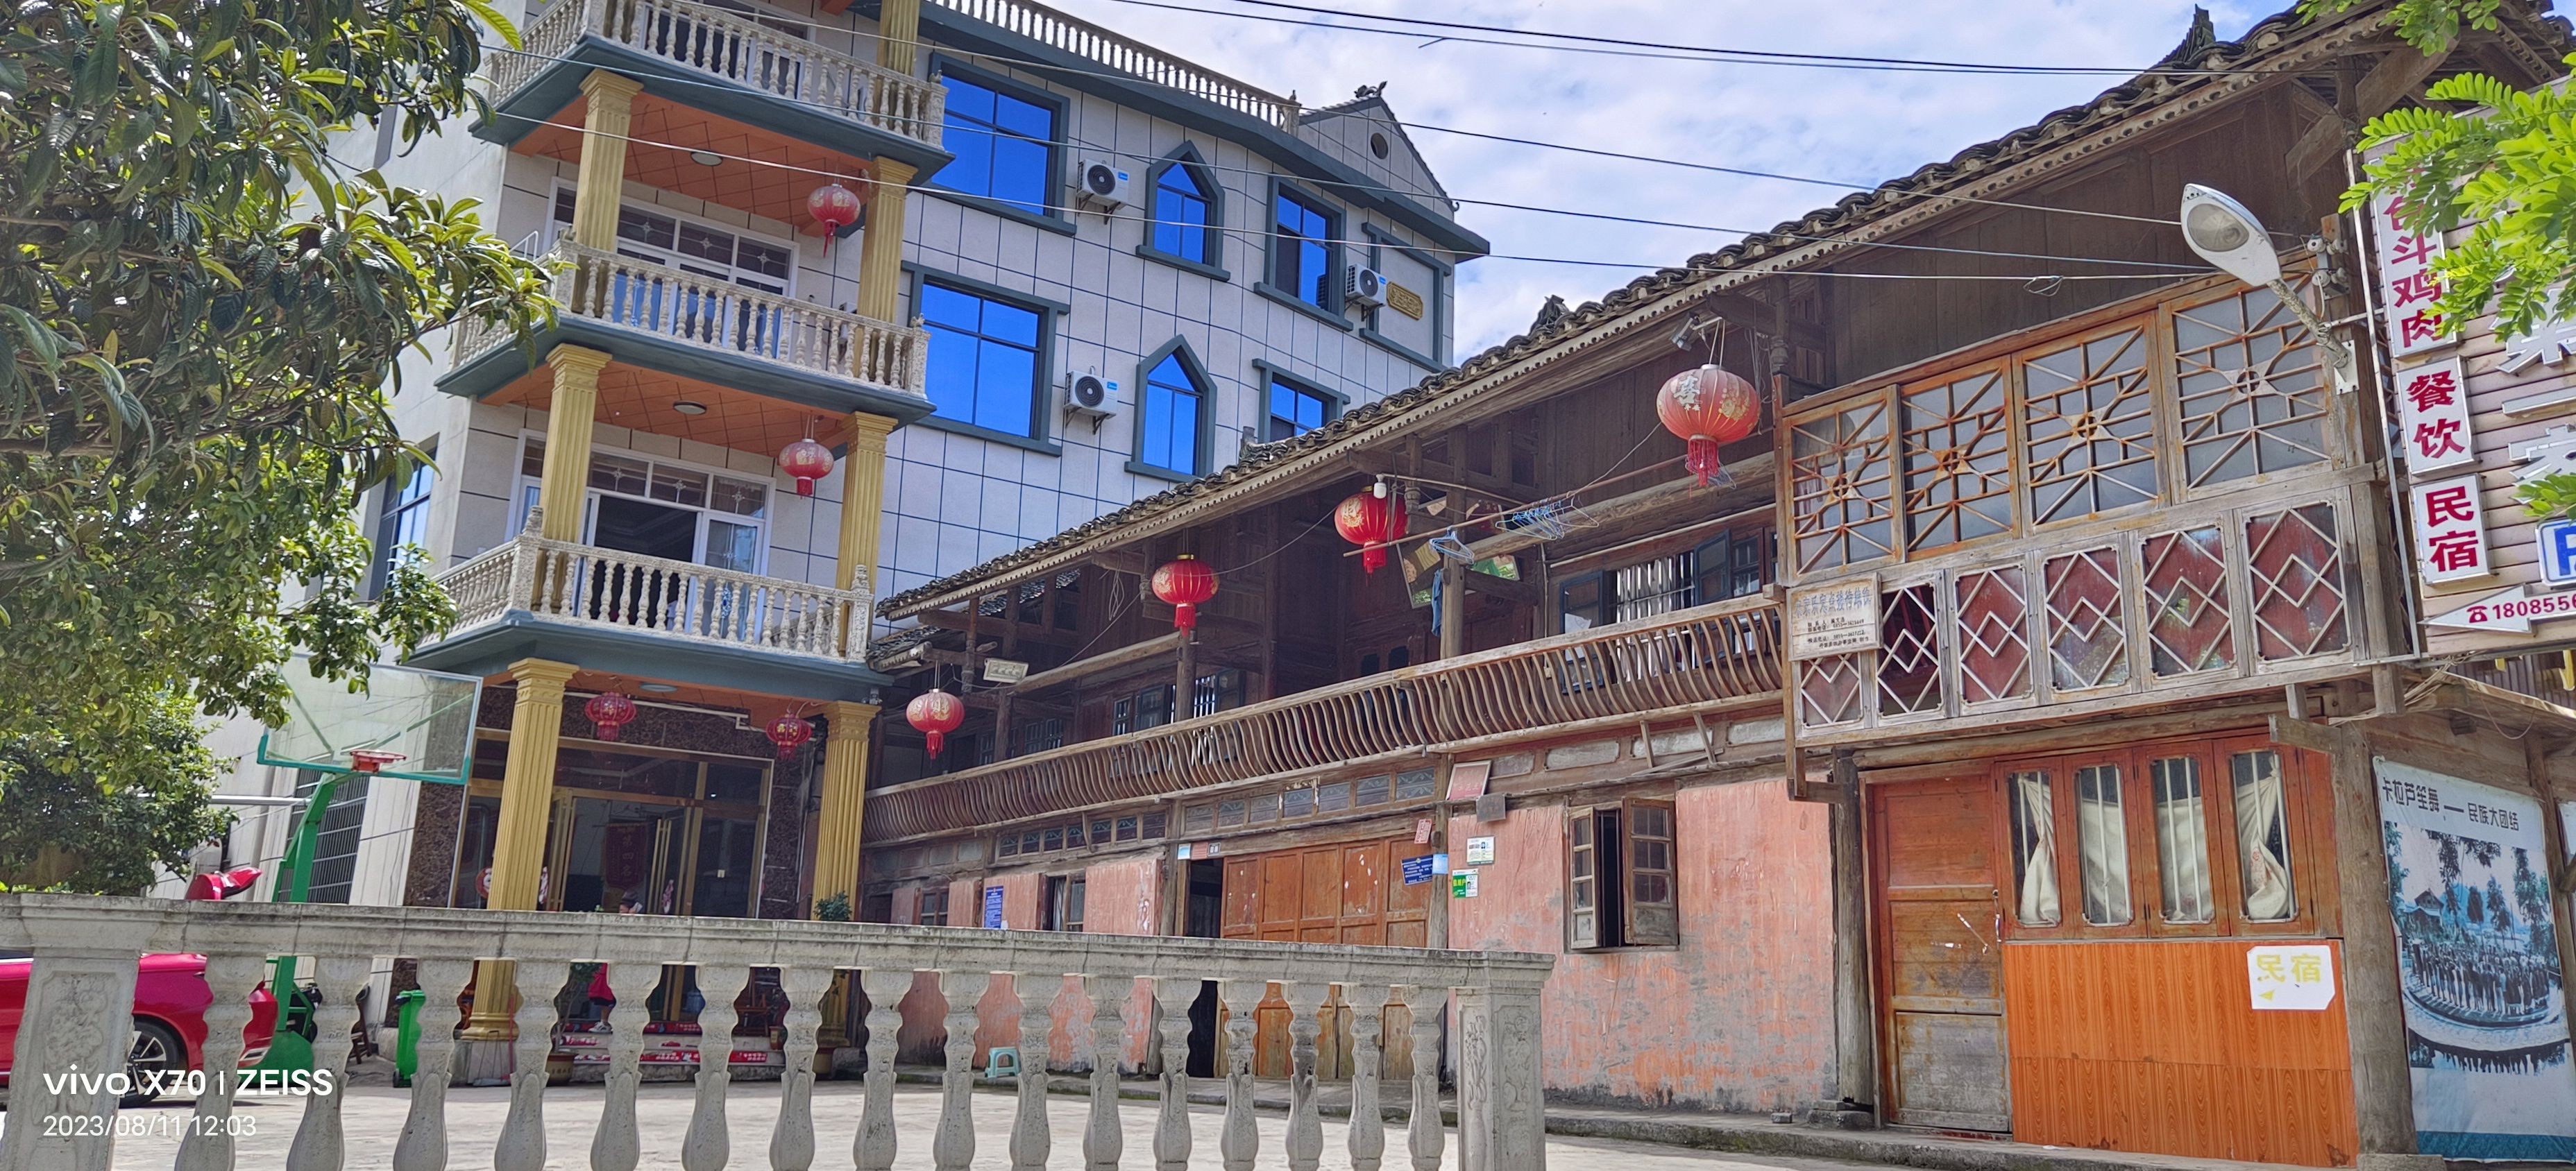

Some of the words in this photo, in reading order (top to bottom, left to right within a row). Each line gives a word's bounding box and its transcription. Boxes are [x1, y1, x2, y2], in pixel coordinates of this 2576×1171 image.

[2383, 163, 2443, 348] 斗鸡肉
[2407, 369, 2466, 459] 餐饮
[2425, 486, 2480, 572] 民宿
[2256, 952, 2321, 983] 民宿
